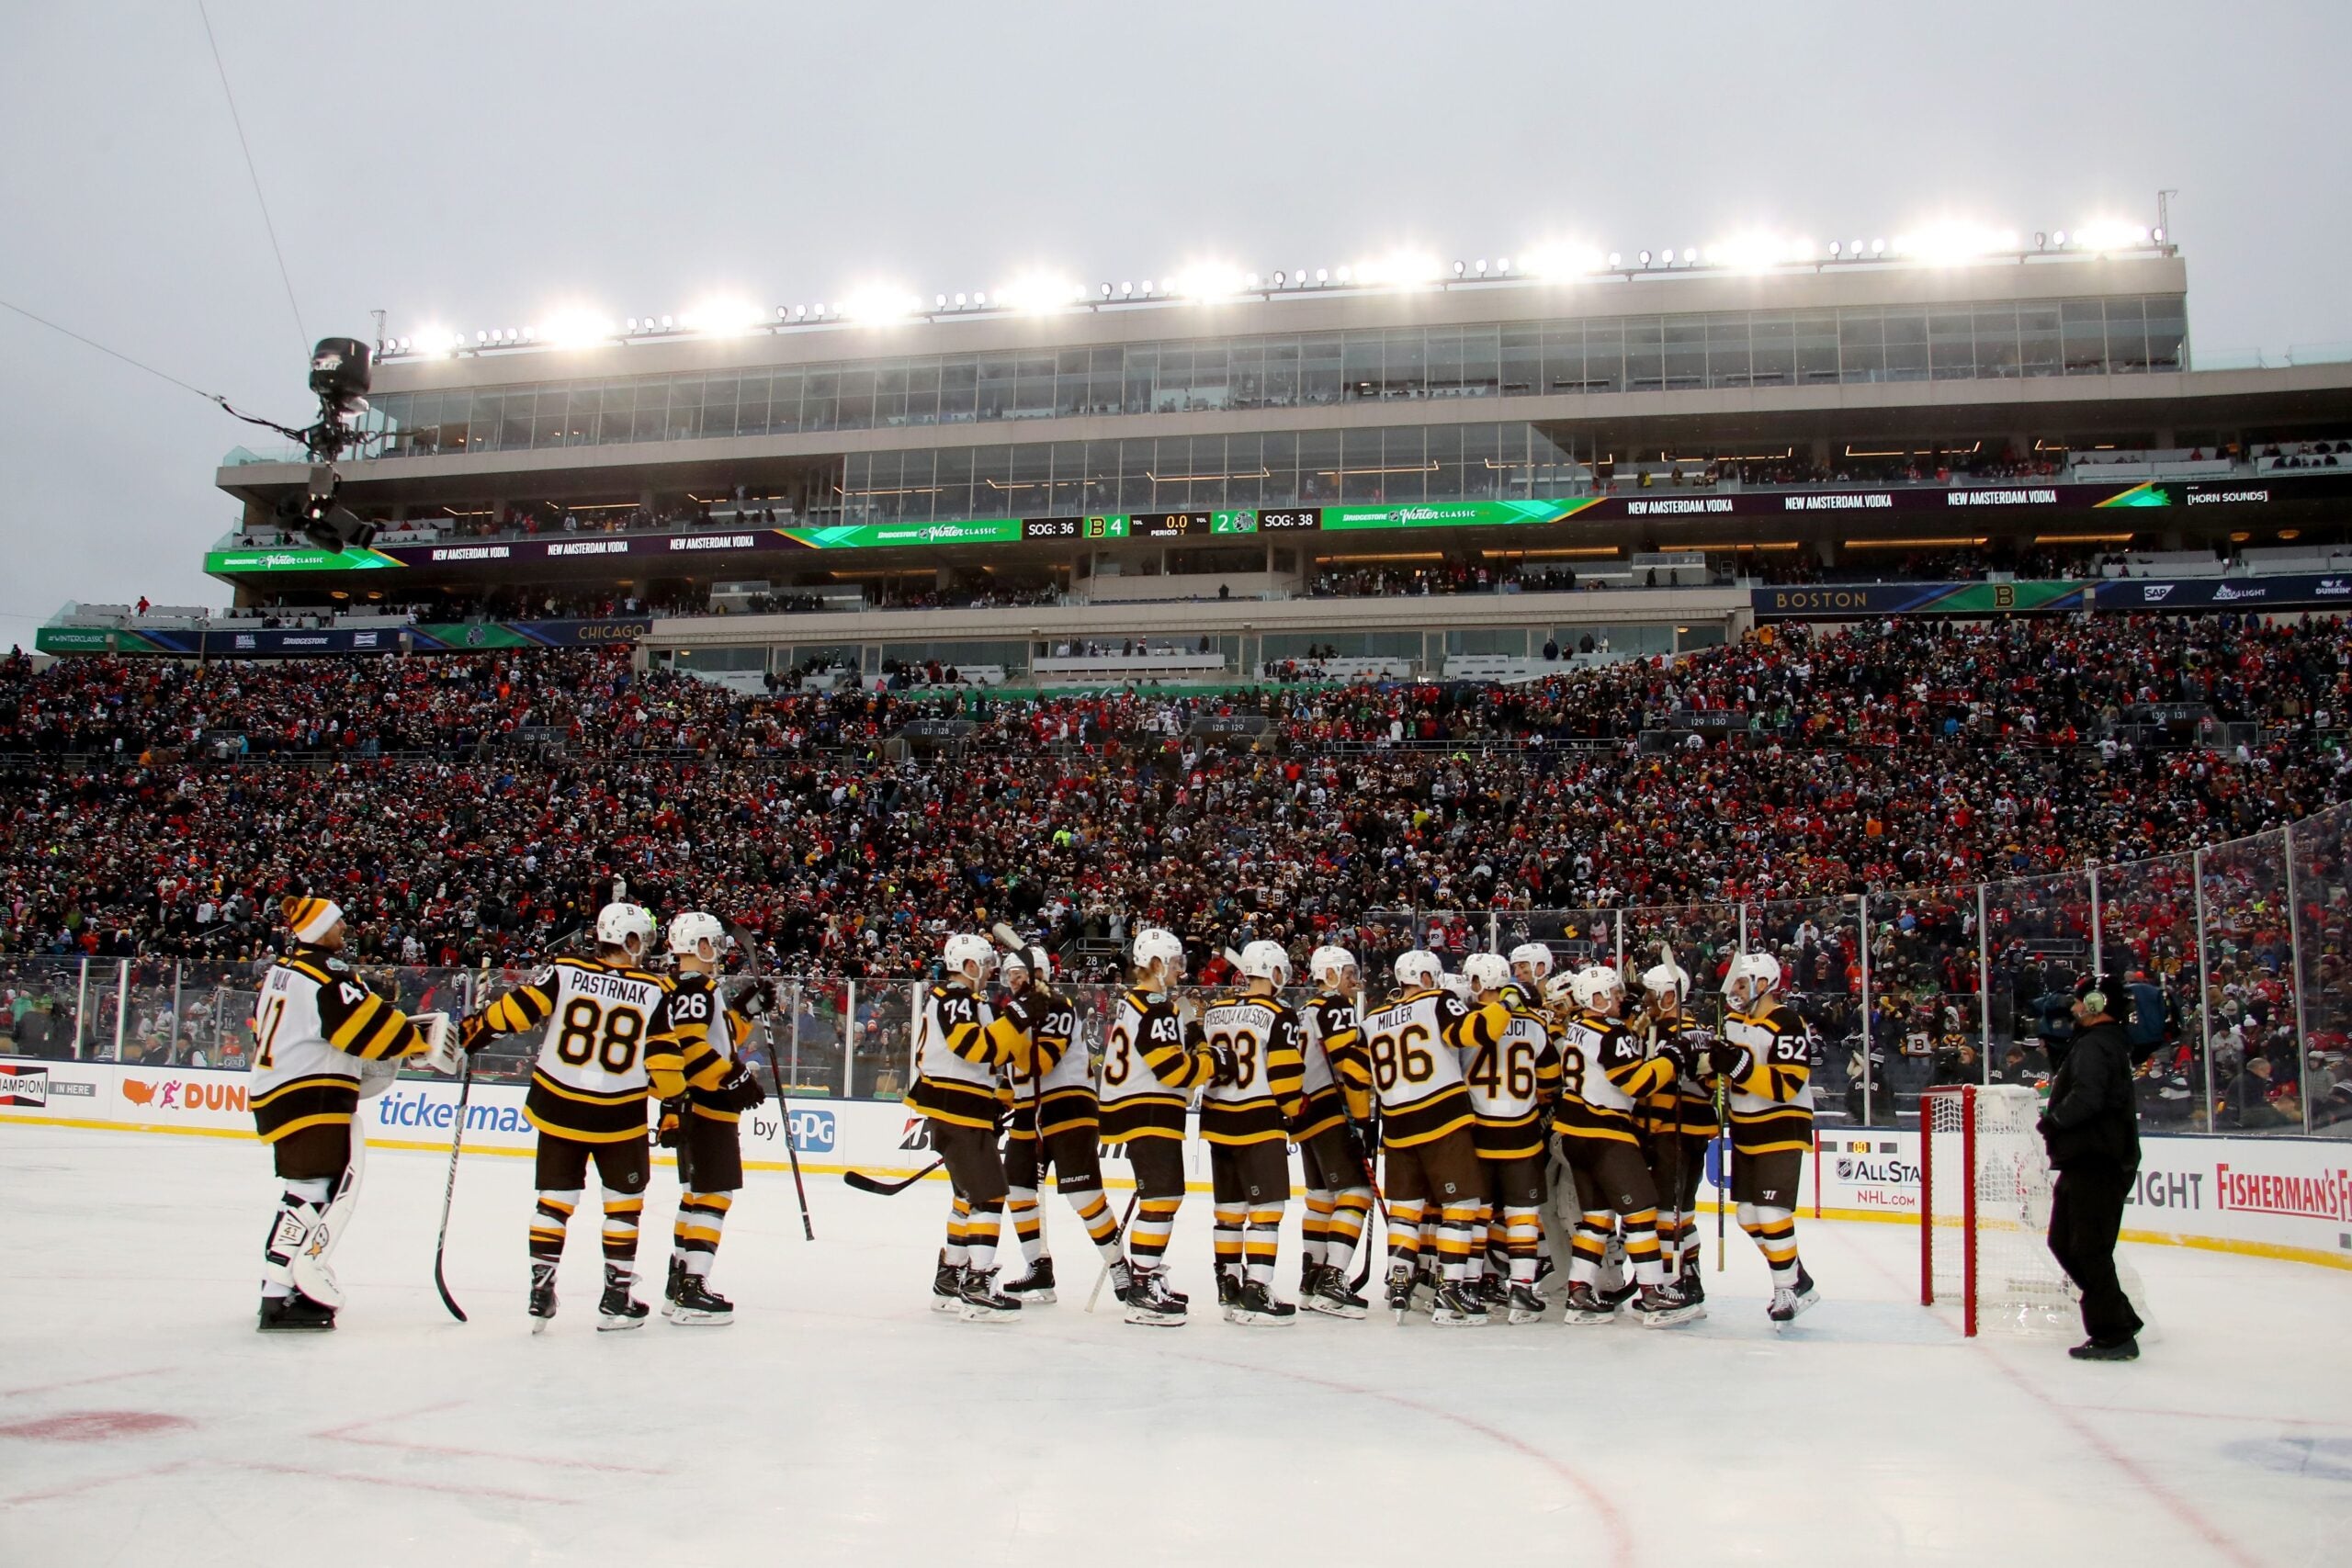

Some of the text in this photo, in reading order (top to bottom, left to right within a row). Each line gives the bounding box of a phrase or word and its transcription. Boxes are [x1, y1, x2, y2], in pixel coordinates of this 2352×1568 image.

[1785, 497, 1804, 510] NEW
[1948, 492, 1968, 505] NEW
[2188, 491, 2268, 505] [HORN SOUNDS]
[1628, 502, 1647, 514] NEW
[1166, 515, 1188, 529] 0.0
[1217, 514, 1229, 532] 2
[1265, 514, 1313, 526] SOG: 38
[1342, 513, 1386, 522] BRIDGESTONE
[1400, 507, 1439, 525] Winter
[929, 524, 965, 542] Winter
[1028, 523, 1074, 536] SOG: 36
[1110, 518, 1123, 535] 4
[548, 545, 562, 555] NEW
[671, 538, 686, 550] NEW
[266, 554, 296, 569] Winter
[433, 549, 447, 560] NEW
[1776, 592, 1867, 608] BOSTON
[2145, 589, 2167, 598] SAP
[2242, 589, 2266, 597] LIGHT
[48, 635, 104, 643] #WINTERCLASSIC
[579, 626, 645, 640] CHICAGO
[961, 937, 968, 945] B
[1086, 956, 1098, 966] 28
[1590, 970, 1599, 978] B
[571, 971, 650, 1005] PASTRNAK
[675, 993, 707, 1020] 26
[944, 998, 973, 1024] 74
[1041, 1010, 1072, 1036] 20
[1329, 1008, 1356, 1031] 27
[1378, 1007, 1412, 1032] MILLER
[557, 996, 646, 1075] 88
[1150, 1017, 1178, 1043] 43
[1777, 1035, 1807, 1061] 52
[1914, 1039, 1925, 1051] B
[224, 1058, 245, 1067] GOLD
[1369, 1023, 1435, 1093] 86
[1467, 1042, 1535, 1100] 46
[2022, 1069, 2050, 1081] CHIAGO
[55, 1084, 90, 1095] IN HERE
[1855, 1081, 1879, 1091] CHGO
[185, 1083, 252, 1112] DUN
[753, 1117, 778, 1141] by
[1854, 1161, 1887, 1181] ALL
[1059, 1174, 1091, 1184] BAUER
[2216, 1163, 2337, 1215] FISHERMAN'S
[1857, 1190, 1916, 1206] NHL.COM
